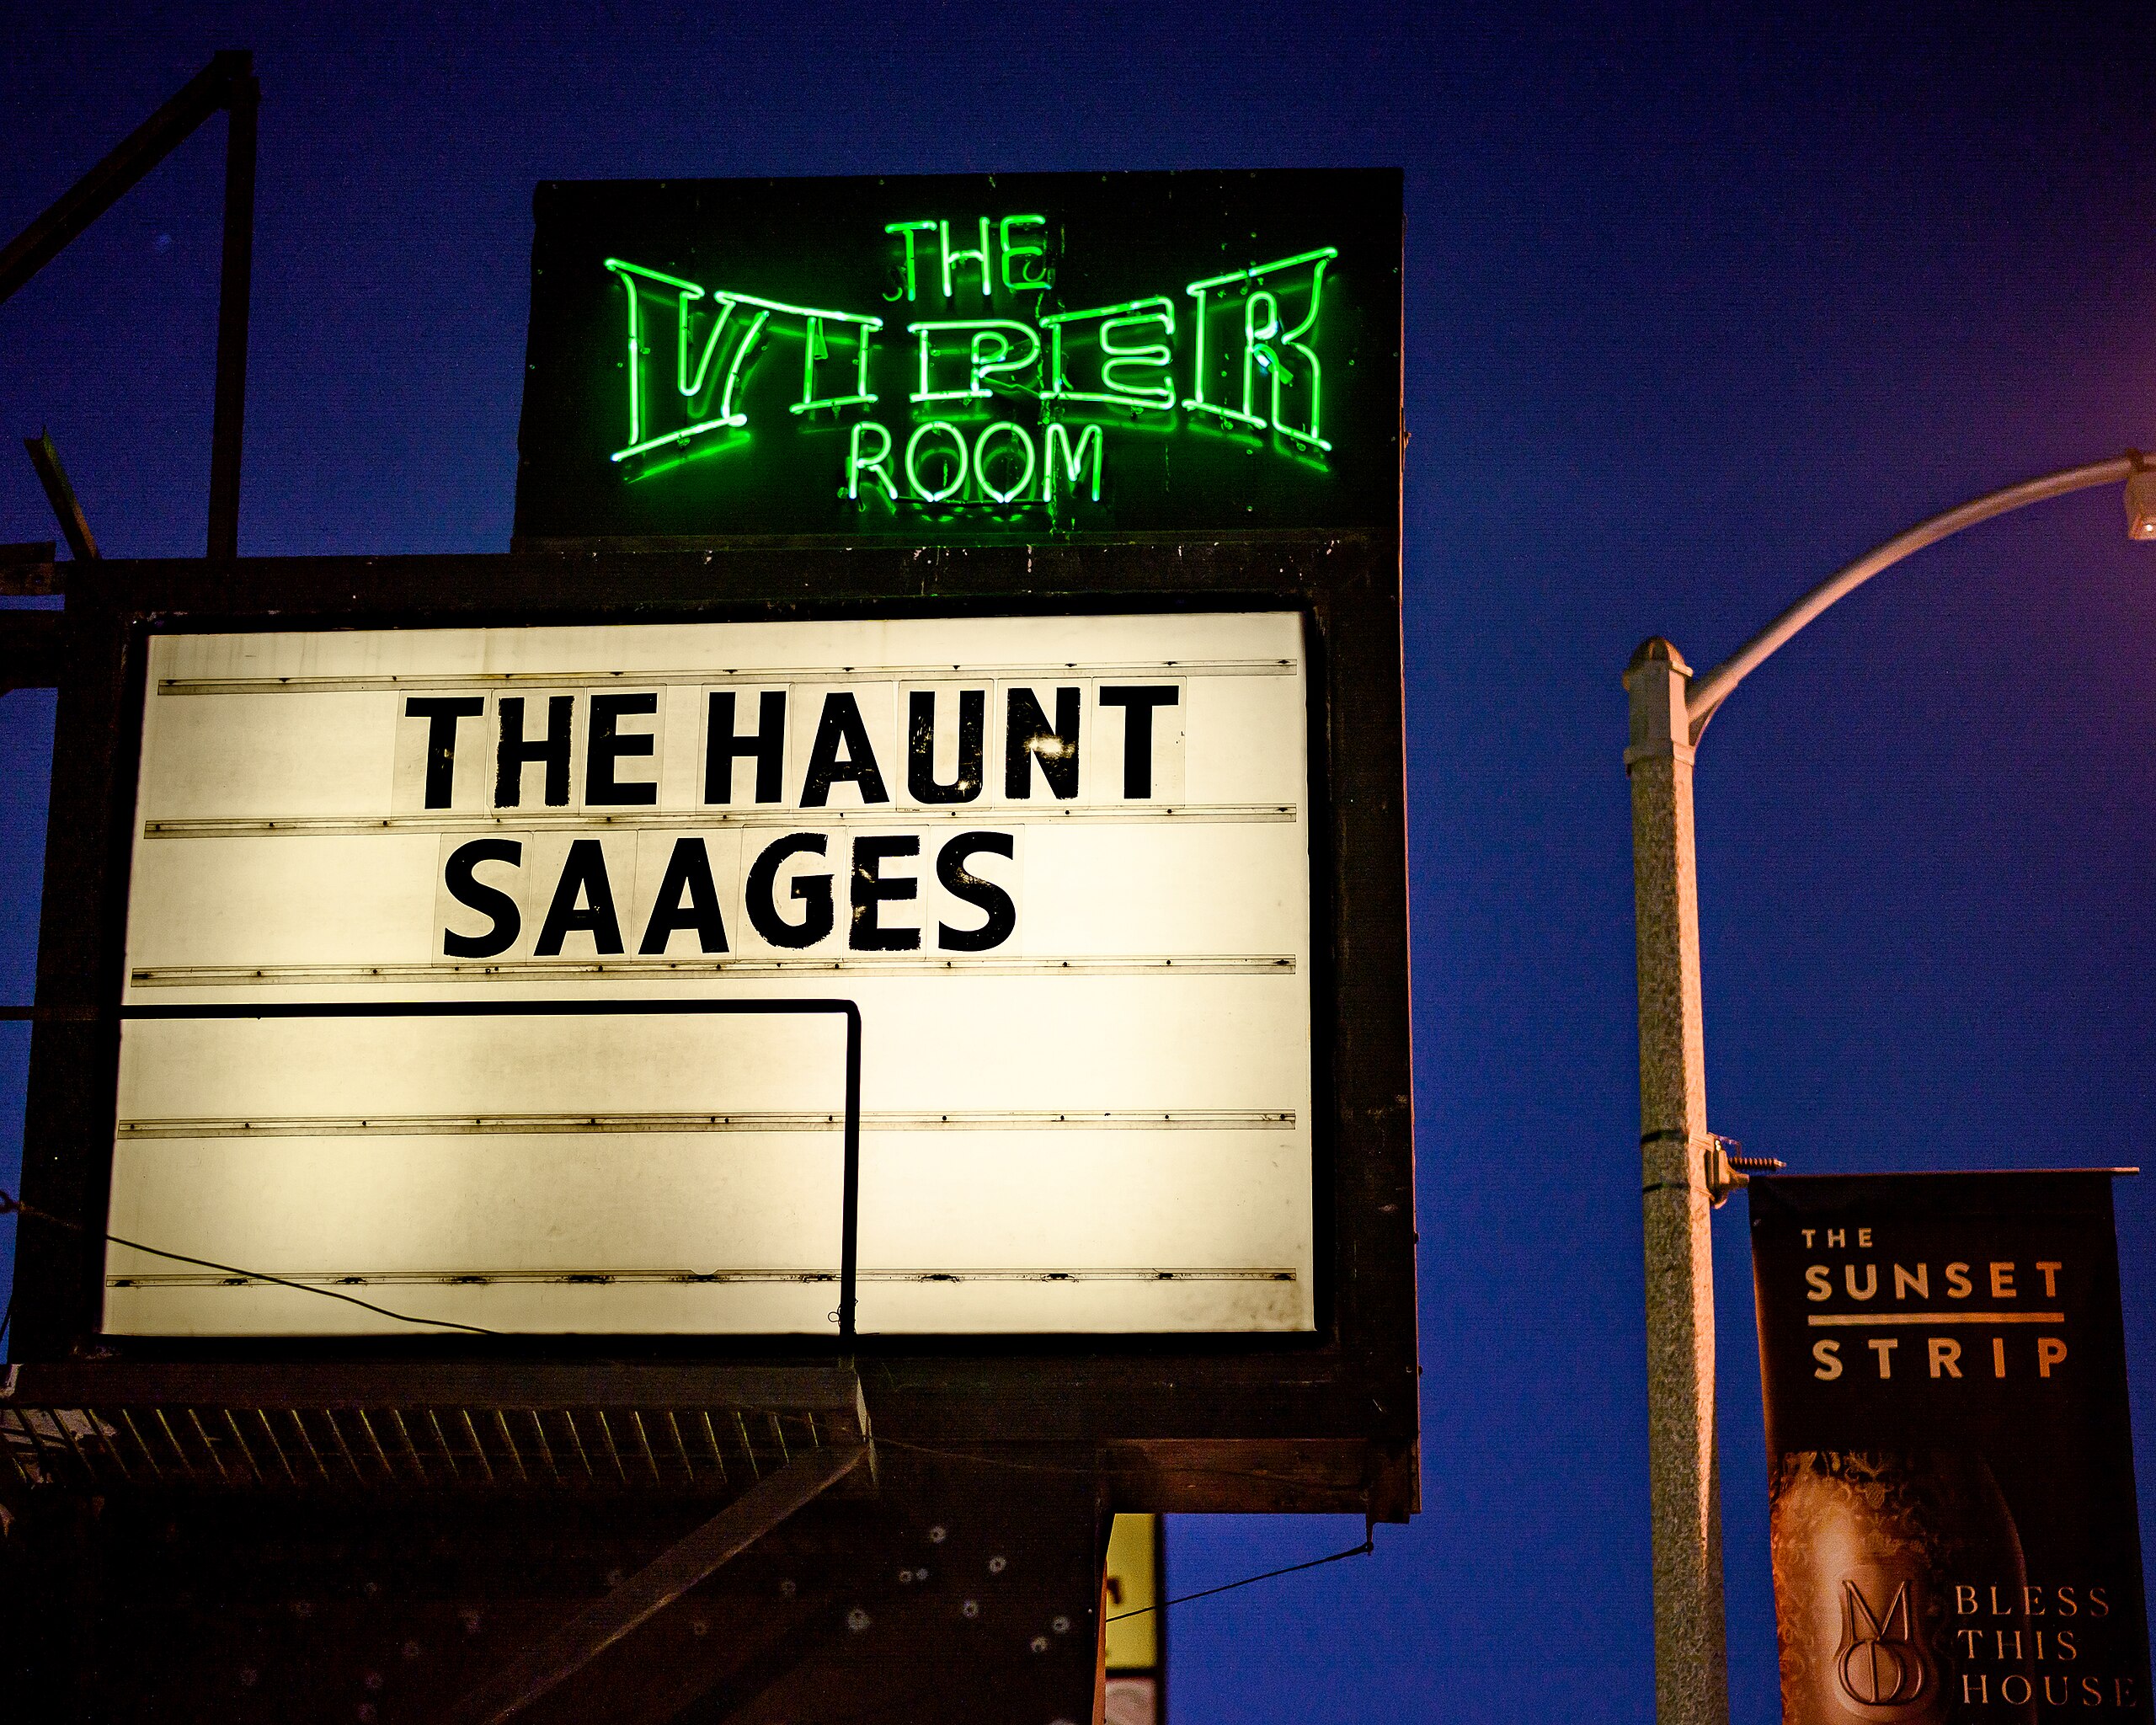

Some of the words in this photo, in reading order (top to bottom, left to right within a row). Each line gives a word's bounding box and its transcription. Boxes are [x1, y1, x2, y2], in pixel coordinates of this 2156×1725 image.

[883, 214, 1053, 302] THE
[603, 247, 1338, 462] VIPER
[846, 421, 1105, 504] ROOM
[404, 692, 658, 810] THE
[703, 685, 1180, 809] HAUNT
[442, 830, 1017, 959] SAAGES
[1801, 1227, 1874, 1249] THE
[1805, 1262, 2063, 1301] SUNSET
[1812, 1338, 2068, 1381] STRIP
[1955, 1585, 2110, 1617] BLESS
[1956, 1629, 2078, 1661] THIS
[1961, 1674, 2138, 1707] HOUSE
